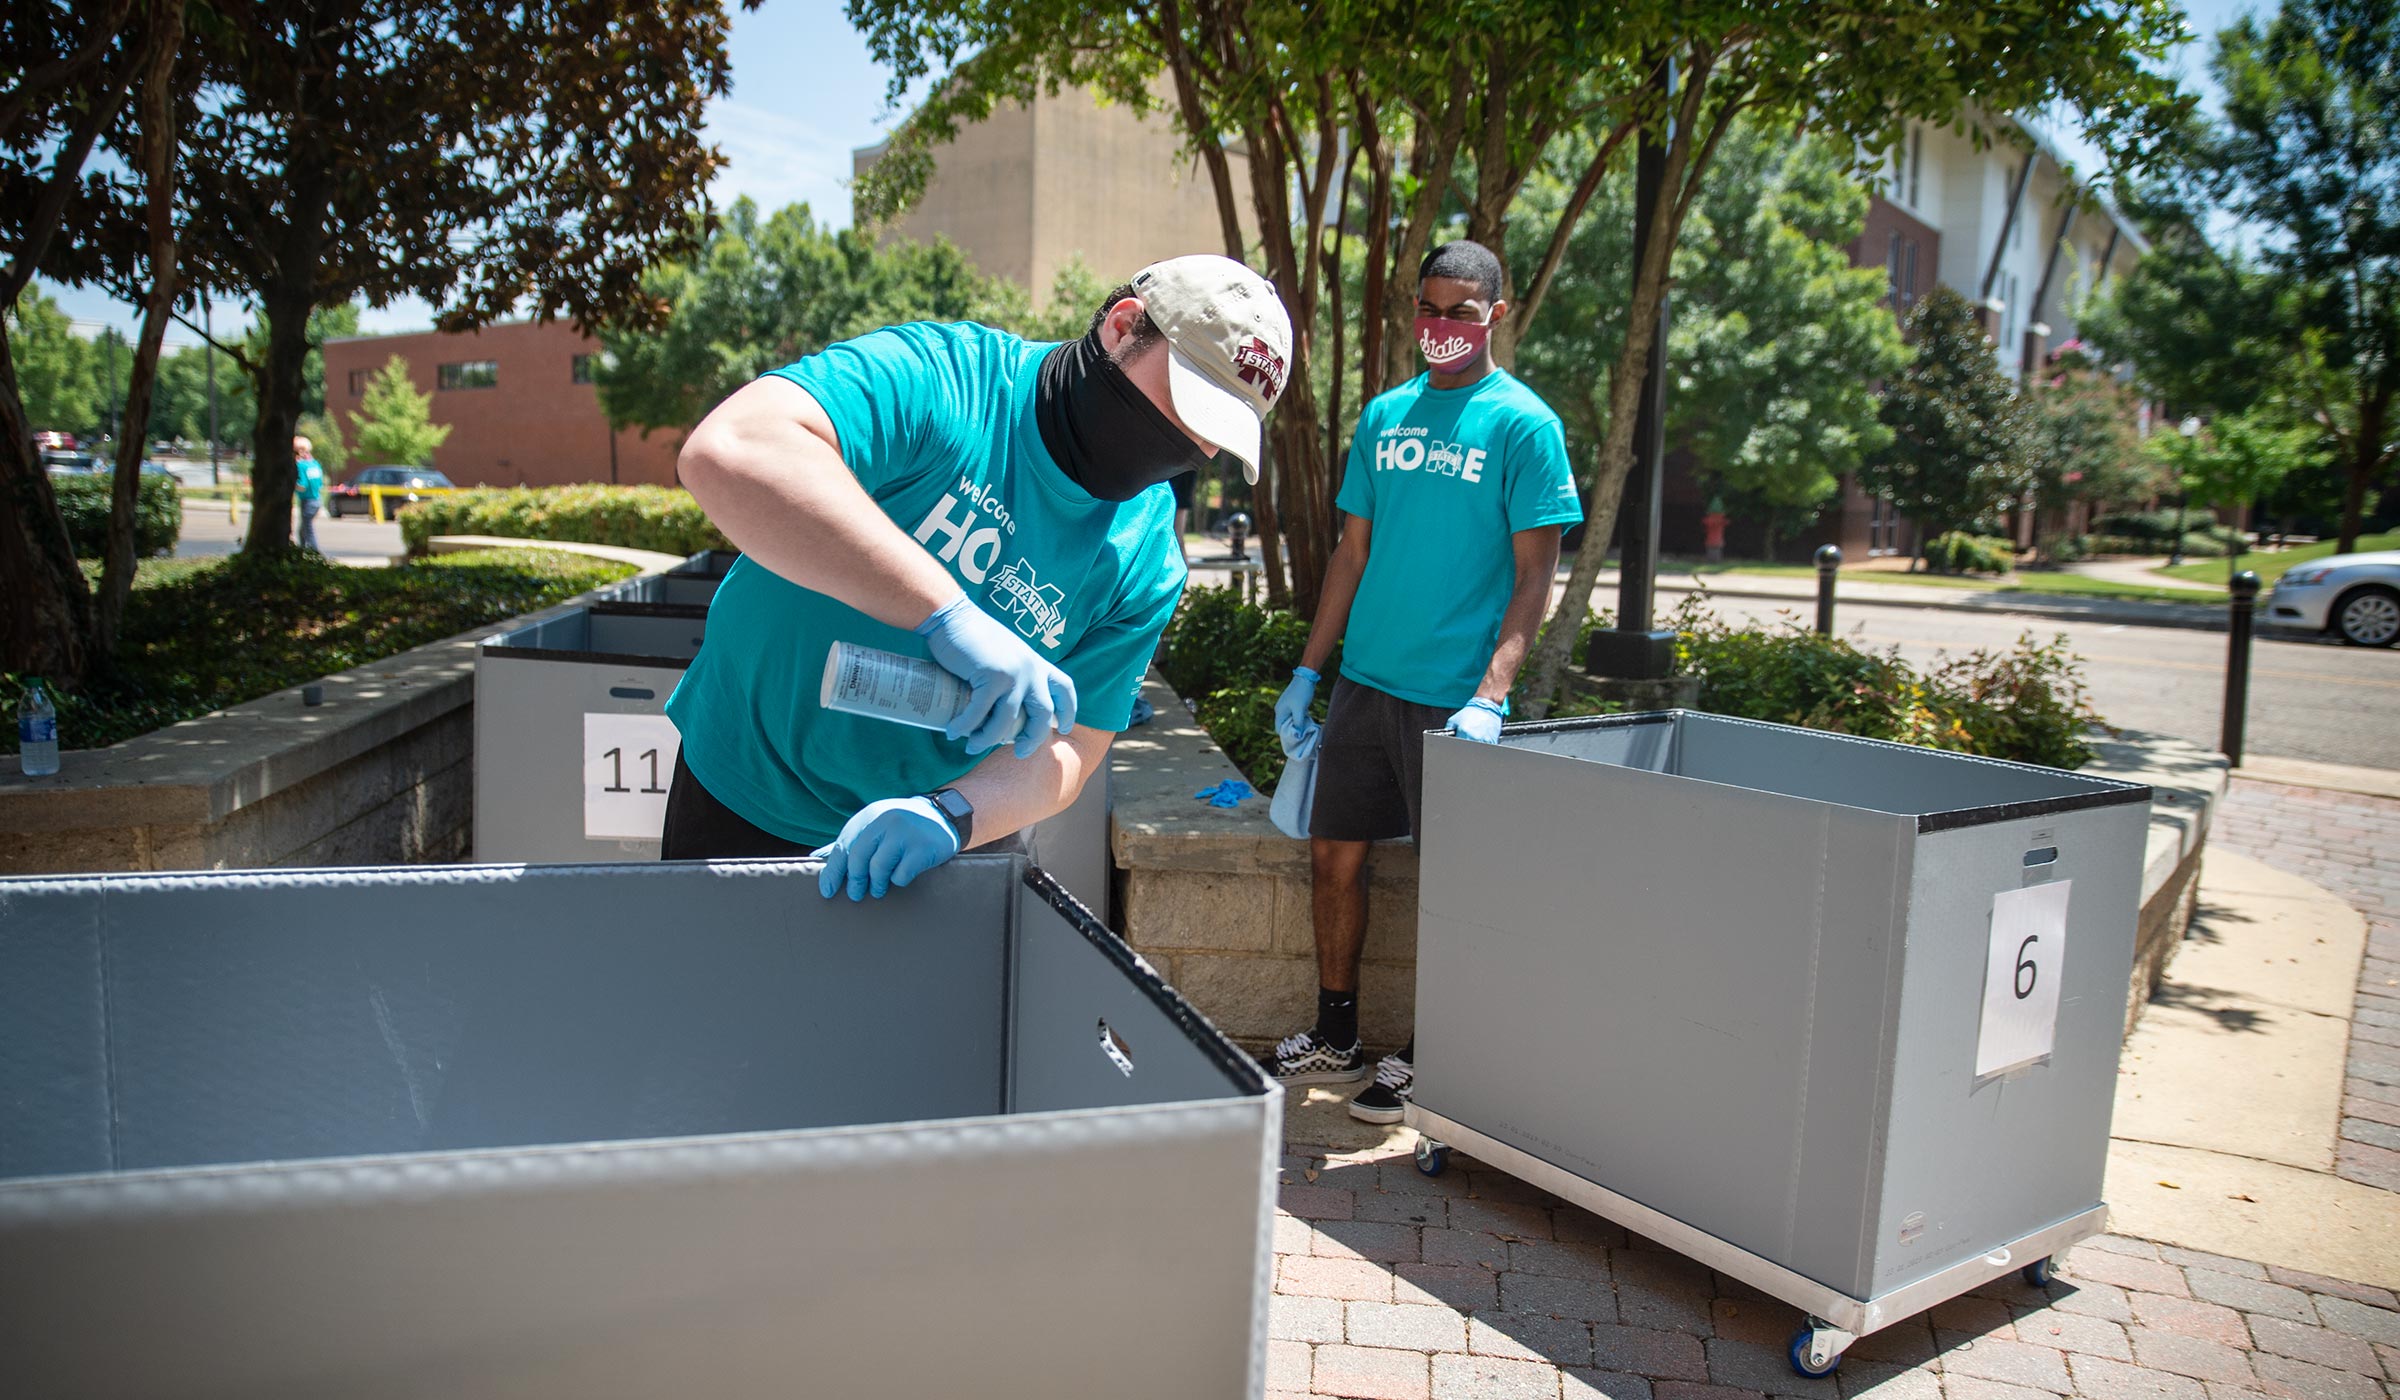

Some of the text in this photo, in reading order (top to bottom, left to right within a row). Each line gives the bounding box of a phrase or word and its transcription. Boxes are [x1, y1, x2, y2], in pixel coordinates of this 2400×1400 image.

[1420, 328, 1472, 363] State
[1380, 423, 1428, 437] welcome
[1376, 438, 1487, 483] HOME
[959, 476, 1016, 536] welcome
[1006, 577, 1047, 620] STATE
[603, 747, 667, 794] 11
[2014, 934, 2039, 1000] 6
